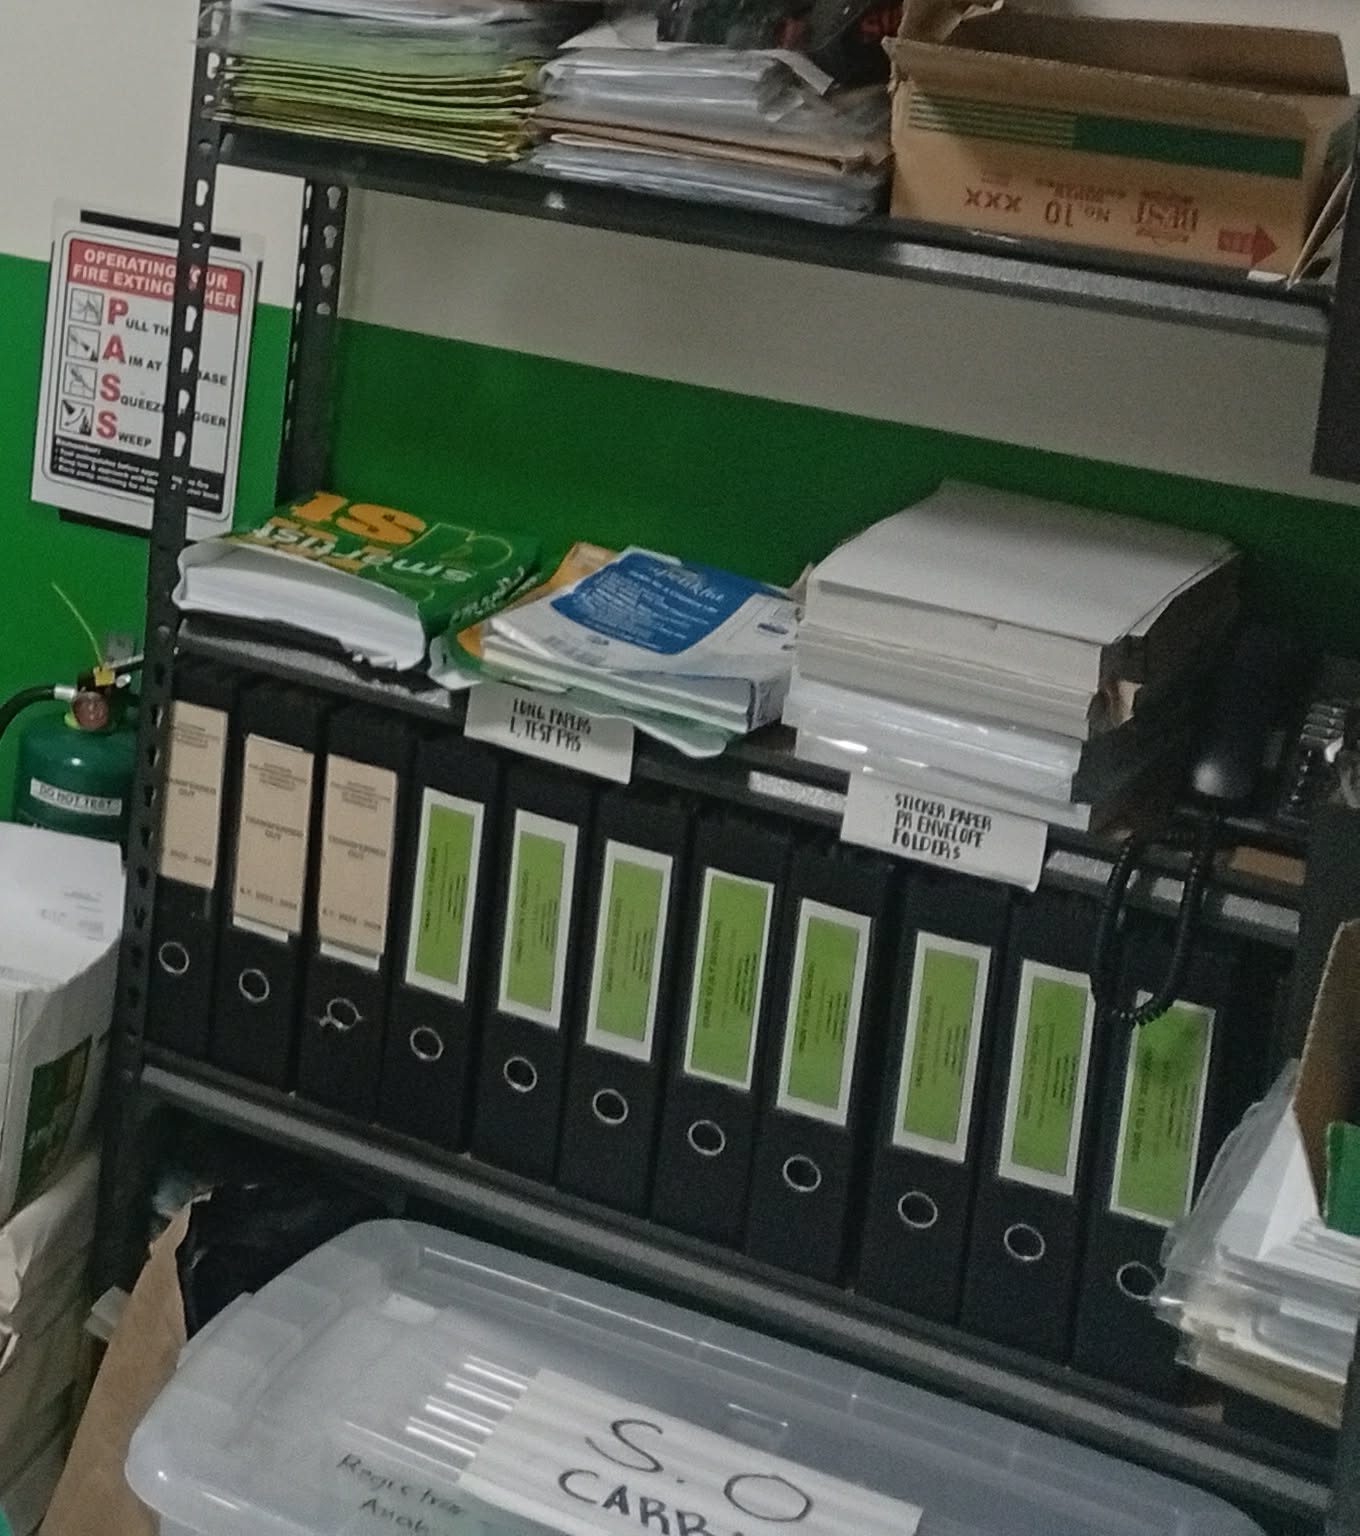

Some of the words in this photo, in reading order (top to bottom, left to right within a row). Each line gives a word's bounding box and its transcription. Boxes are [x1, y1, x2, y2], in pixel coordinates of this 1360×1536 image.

[84, 248, 177, 279] OPERATING
[72, 264, 109, 283] FIRE
[113, 272, 237, 309] EXTINGHER
[153, 323, 170, 337] TH
[146, 359, 163, 372] AT
[100, 373, 165, 415] SQUEEZ
[526, 719, 556, 744] TEST
[895, 792, 946, 820] STICKER
[949, 807, 992, 833] PAPER
[892, 827, 961, 860] FOLDERS
[917, 815, 984, 849] ENVELOPE
[558, 1468, 744, 1536] CARB
